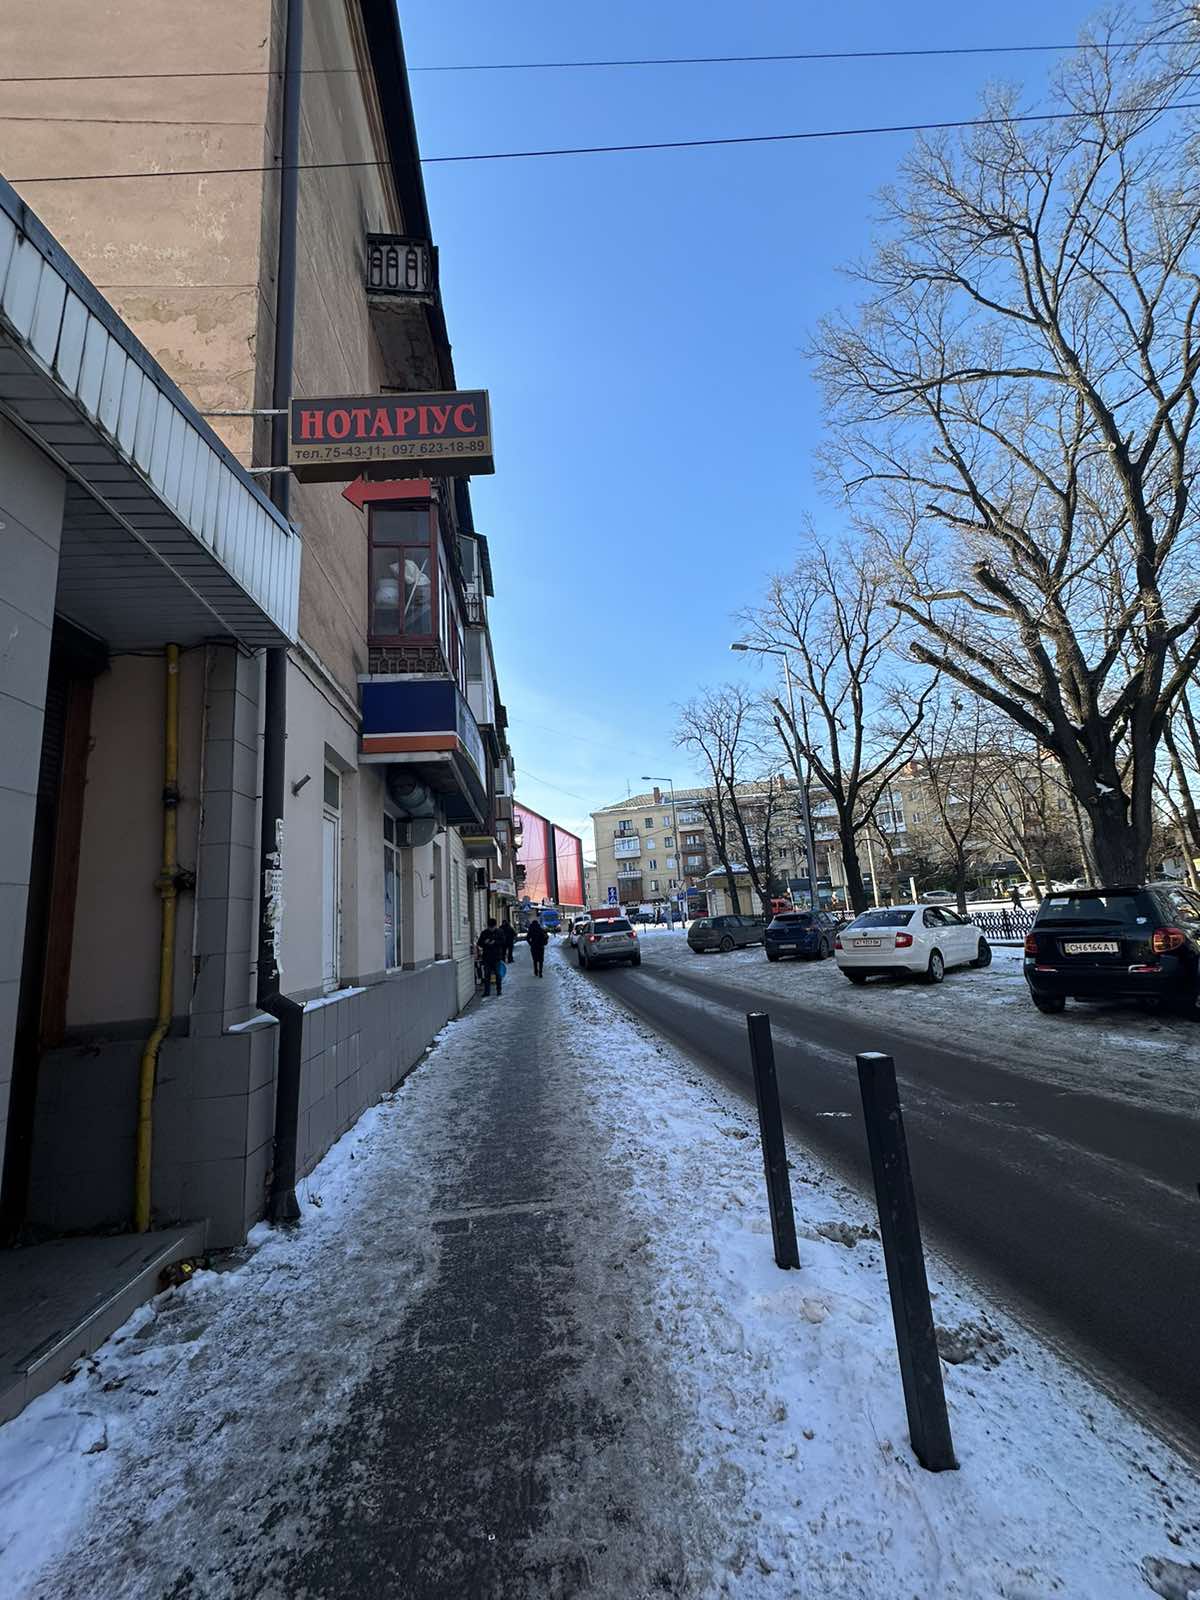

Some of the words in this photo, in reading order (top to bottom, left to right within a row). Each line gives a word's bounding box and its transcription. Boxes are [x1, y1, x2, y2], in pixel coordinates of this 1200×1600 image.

[299, 402, 478, 440] НОТАРІУС
[392, 443, 416, 455] 097
[419, 440, 485, 453] 623-18-89
